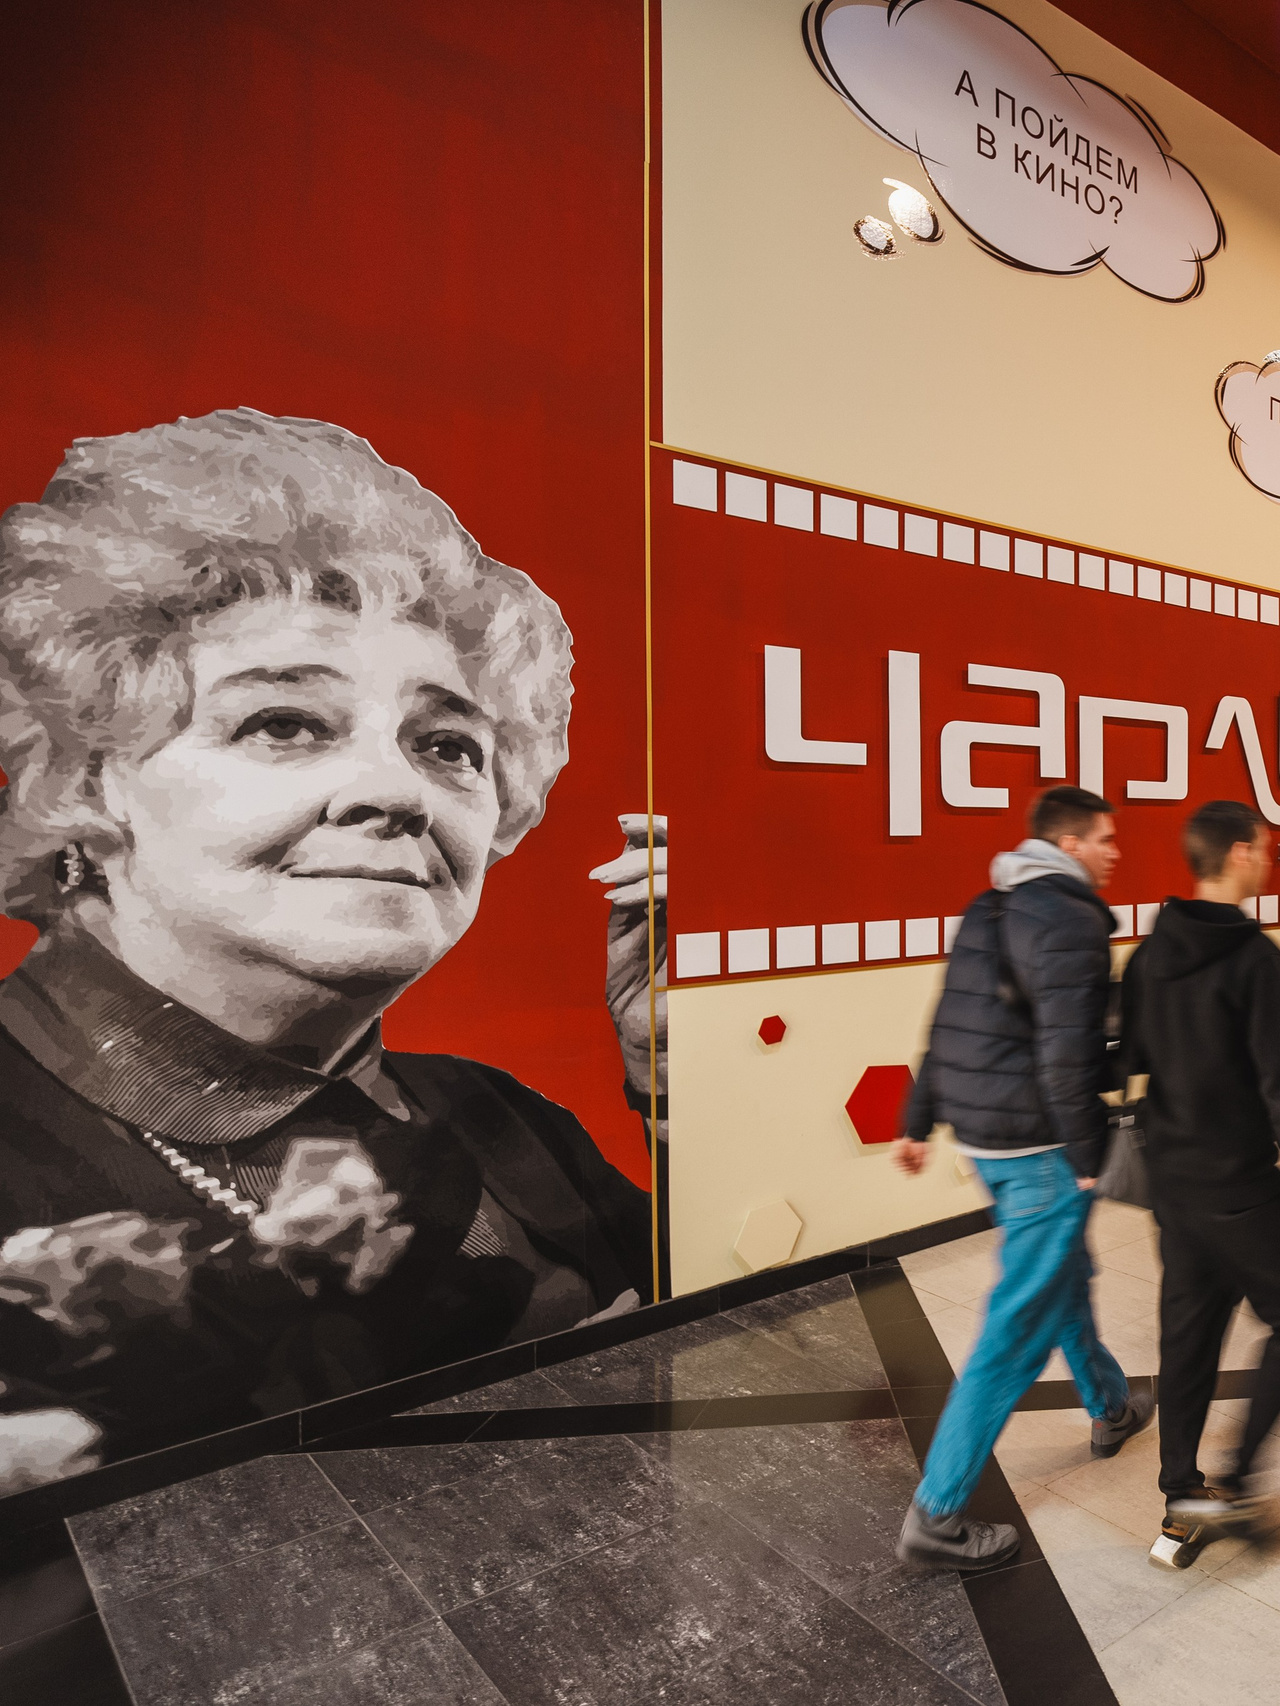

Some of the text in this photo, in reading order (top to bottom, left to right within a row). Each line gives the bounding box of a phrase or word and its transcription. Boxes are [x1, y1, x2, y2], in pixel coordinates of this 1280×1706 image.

[953, 69, 1140, 196] А ПОЙДЕМ
[976, 123, 1125, 225] В КИНО?
